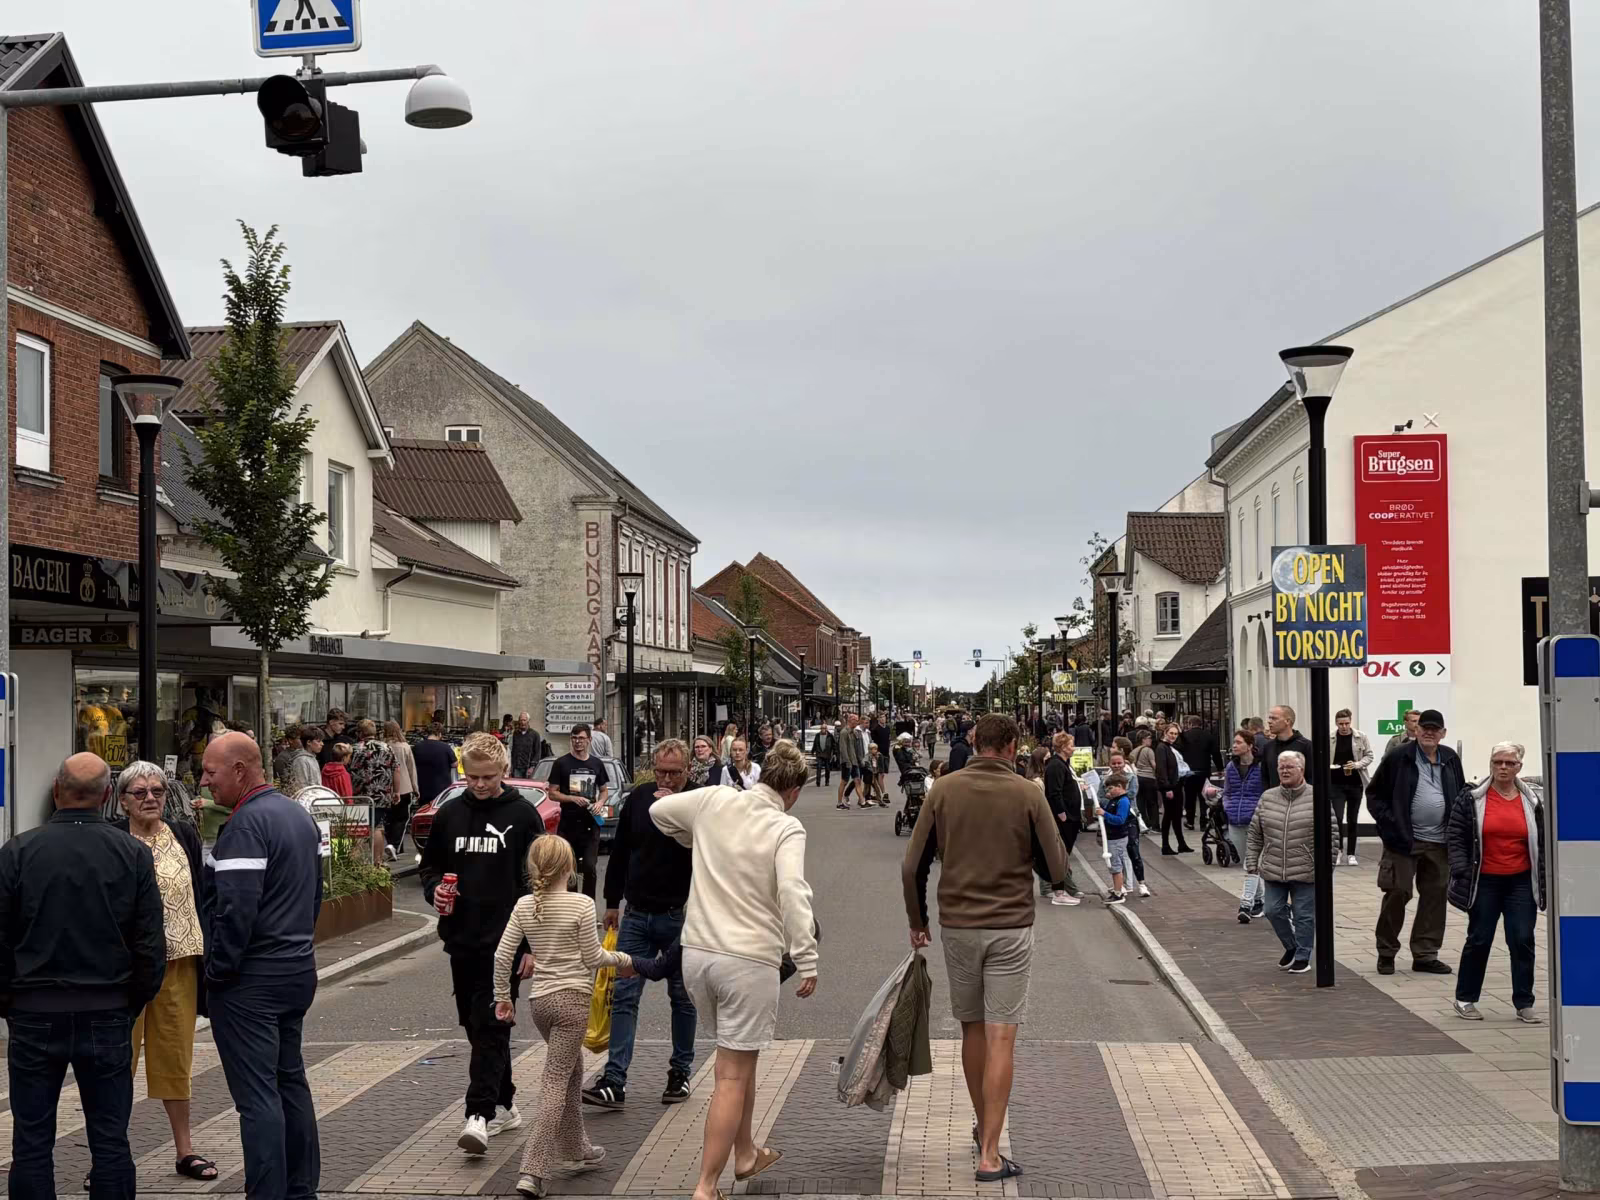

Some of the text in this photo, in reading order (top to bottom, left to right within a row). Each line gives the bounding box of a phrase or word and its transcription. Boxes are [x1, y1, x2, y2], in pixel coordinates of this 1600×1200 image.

[1368, 456, 1434, 475] Brugsen
[1378, 450, 1401, 459] Super
[12, 554, 71, 594] BAGERI
[1293, 553, 1345, 585] OPEN
[585, 522, 602, 688] BUNDGAARD
[1276, 591, 1364, 623] BY NIGHT
[21, 628, 93, 643] BAGER
[1276, 629, 1364, 661] TORSDAG
[1363, 661, 1401, 677] OK
[455, 836, 498, 853] PUMA
